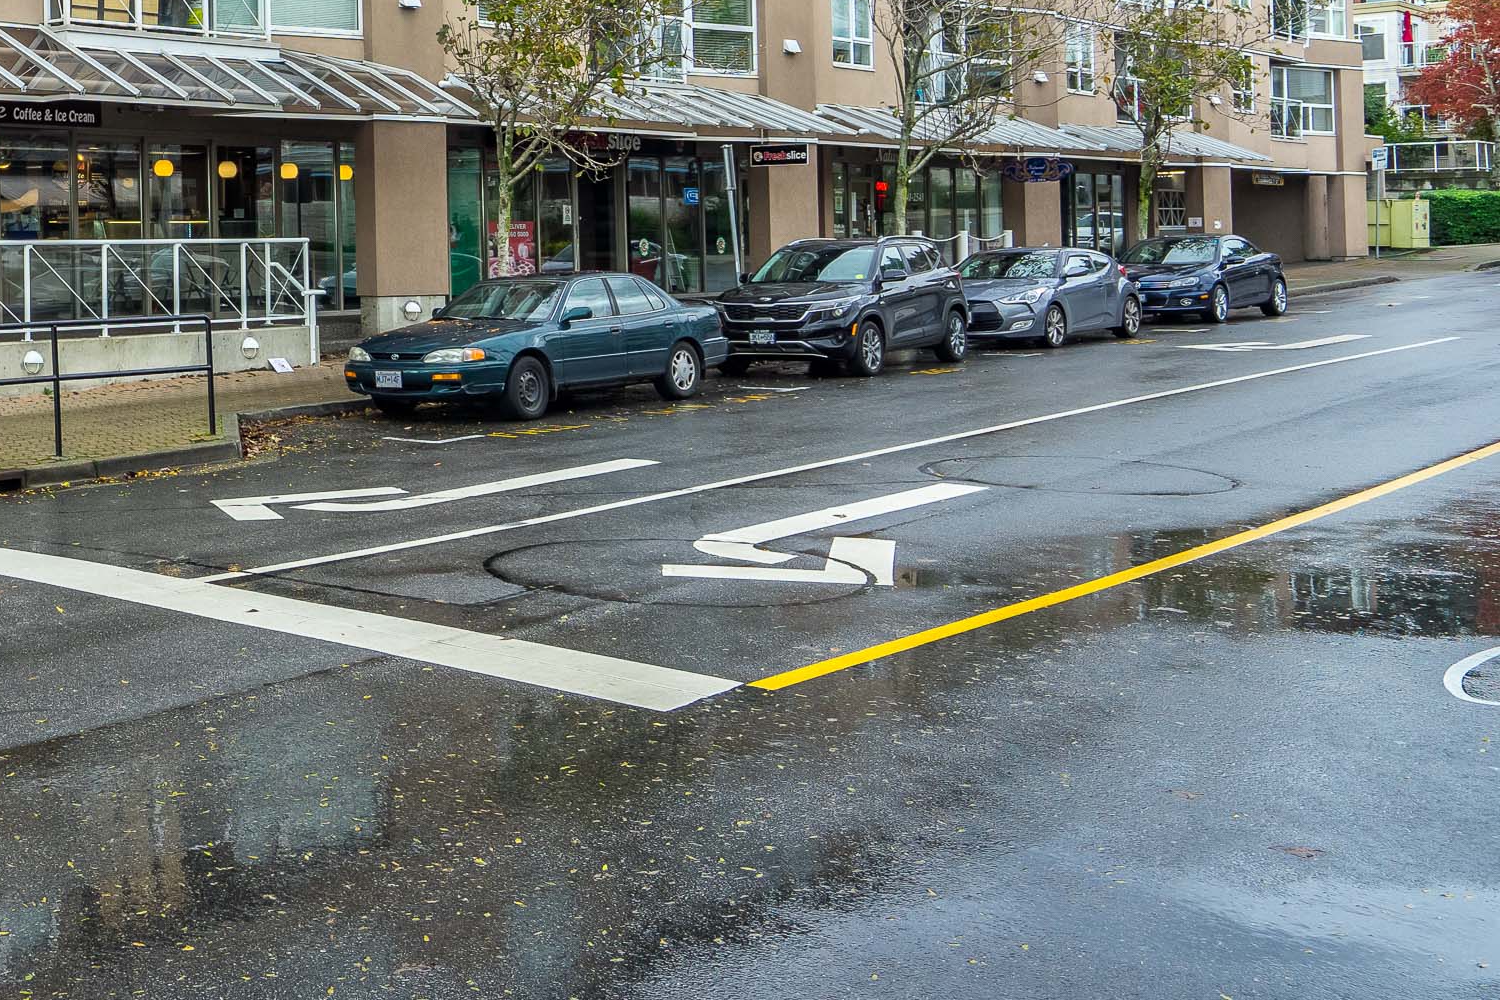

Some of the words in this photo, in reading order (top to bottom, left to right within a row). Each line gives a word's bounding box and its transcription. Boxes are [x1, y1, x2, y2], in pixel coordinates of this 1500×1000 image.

[13, 107, 42, 121] Coffee
[44, 109, 53, 121] &
[55, 109, 67, 122] Ice
[68, 110, 95, 124] Cream
[763, 150, 807, 161] Freshslice
